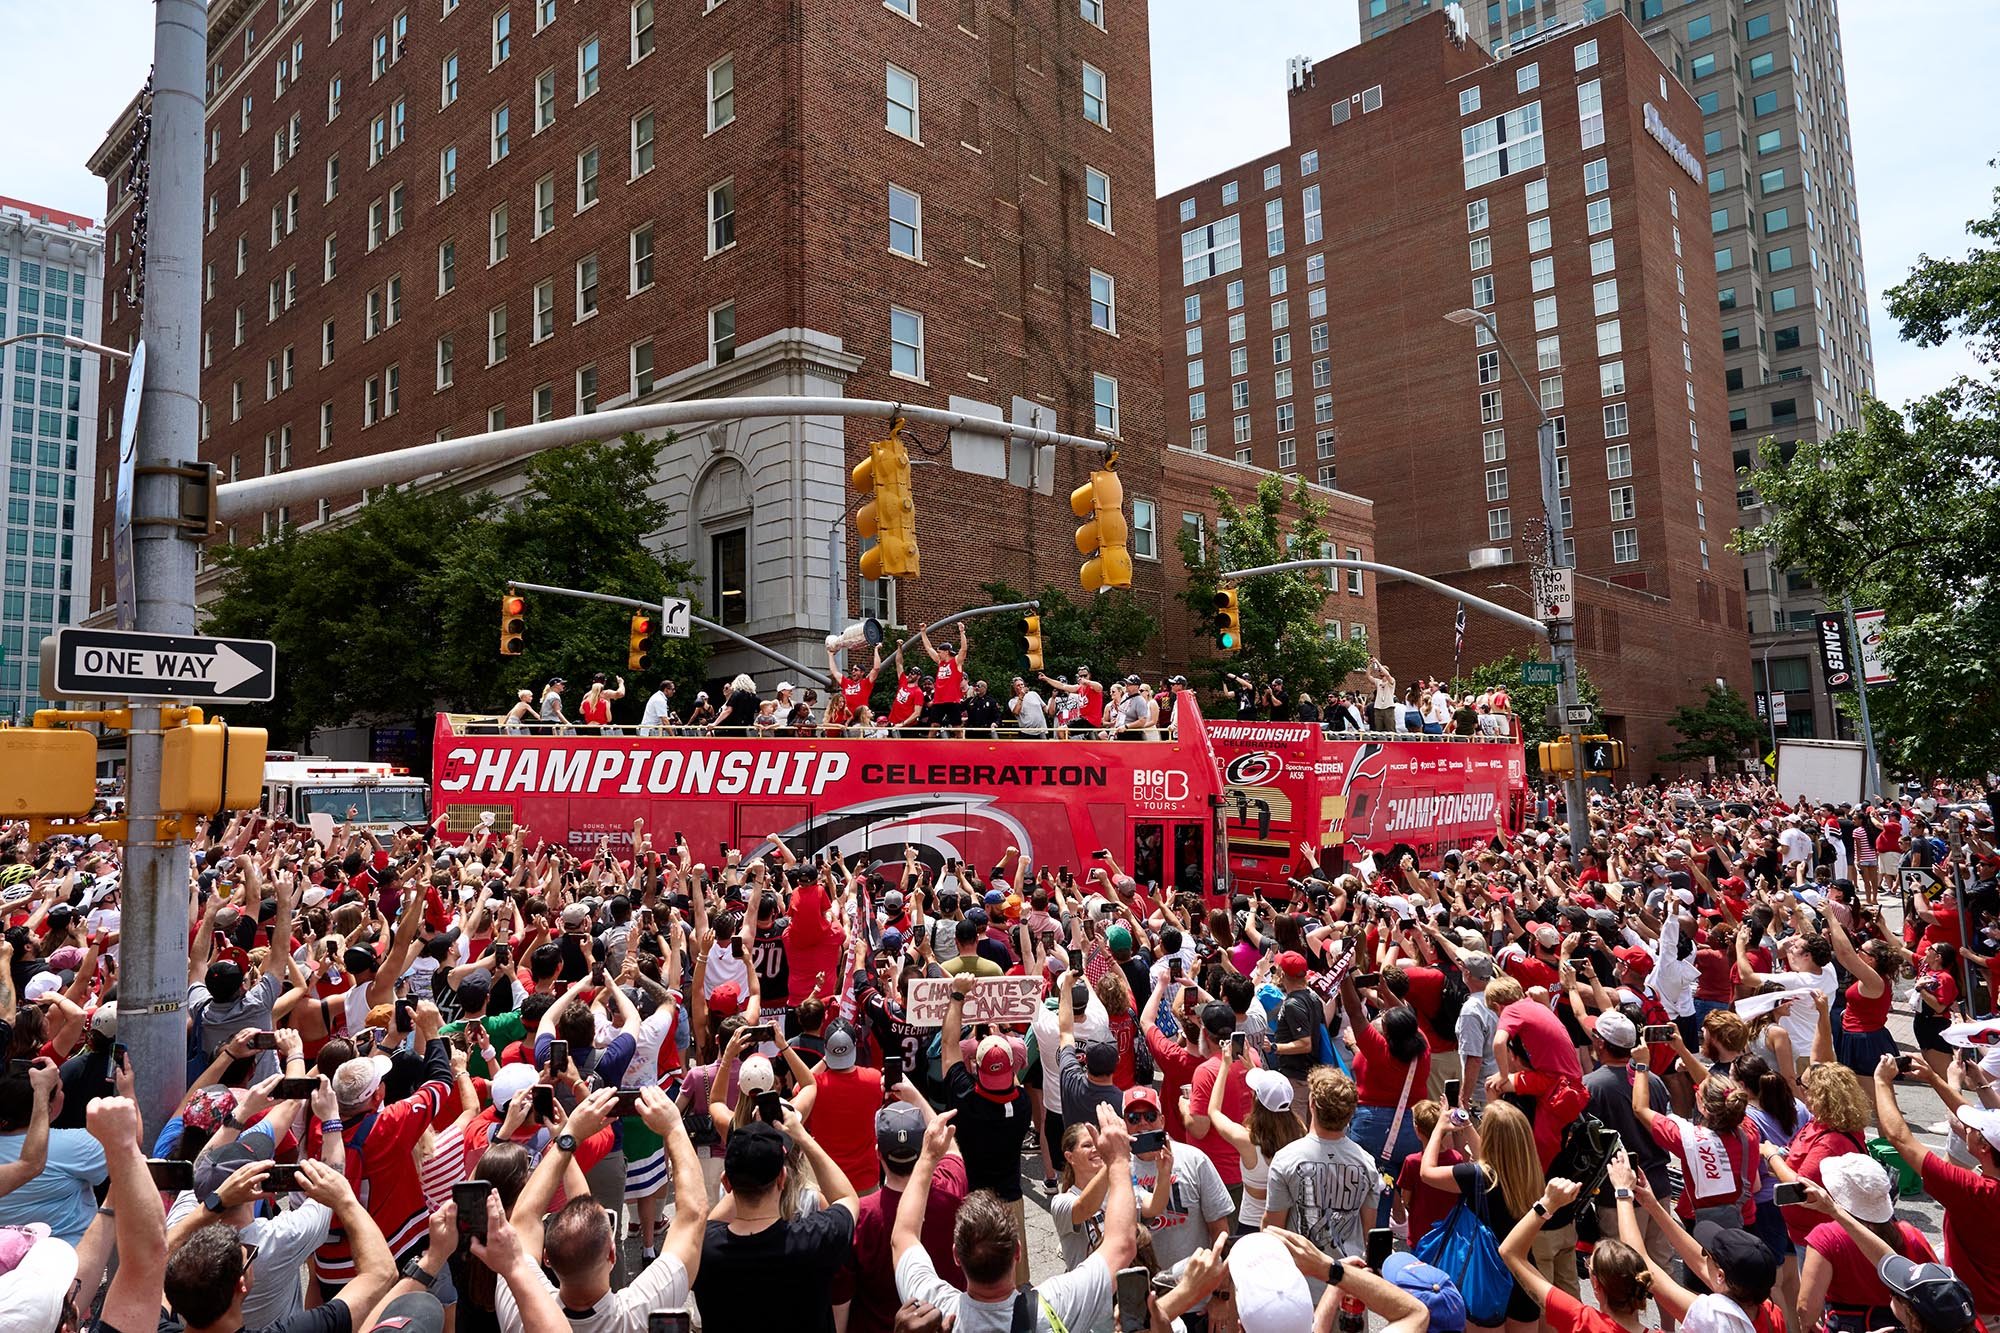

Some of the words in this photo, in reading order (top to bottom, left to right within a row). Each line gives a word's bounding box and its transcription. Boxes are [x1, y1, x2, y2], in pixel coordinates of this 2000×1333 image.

[666, 625, 685, 634] ONLY
[1822, 620, 1844, 670] CANES
[84, 650, 143, 675] ONE
[156, 654, 214, 678] WAY
[1528, 665, 1552, 684] Salisbury
[1206, 726, 1311, 742] CHAMPIONSHIP
[1223, 740, 1288, 749] CELEBRATION
[440, 748, 850, 796] CHAMPIONSHIP
[861, 763, 1107, 786] CELEBRATION
[1133, 769, 1164, 786] BIG
[1314, 762, 1344, 774] SIREN
[1133, 786, 1164, 801] BUS
[1143, 801, 1178, 811] TOURS
[1385, 793, 1494, 831] CHAMPIONSHIP
[913, 980, 1020, 1002] CHAOTTE
[961, 996, 1036, 1019] CANES
[891, 1022, 928, 1036] SVECHN
[1698, 1146, 1721, 1180] ROCK
